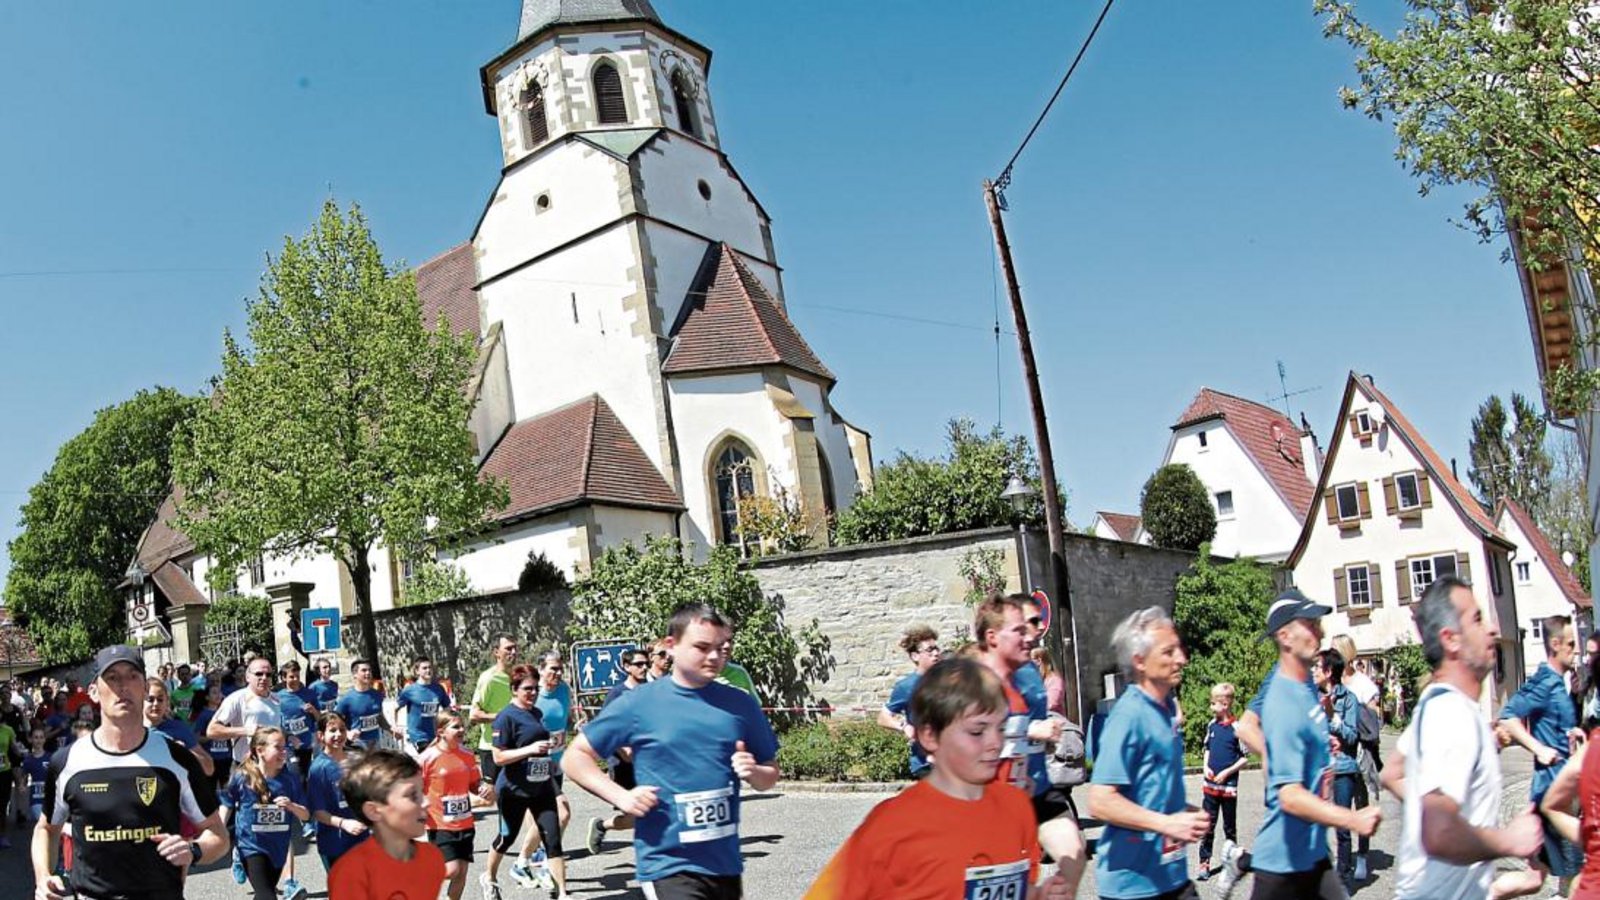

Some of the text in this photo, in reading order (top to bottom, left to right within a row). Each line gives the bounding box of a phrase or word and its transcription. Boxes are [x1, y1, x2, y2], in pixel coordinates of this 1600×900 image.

[260, 811, 282, 822] 224
[692, 802, 727, 824] 220
[84, 825, 162, 843] Ensinger
